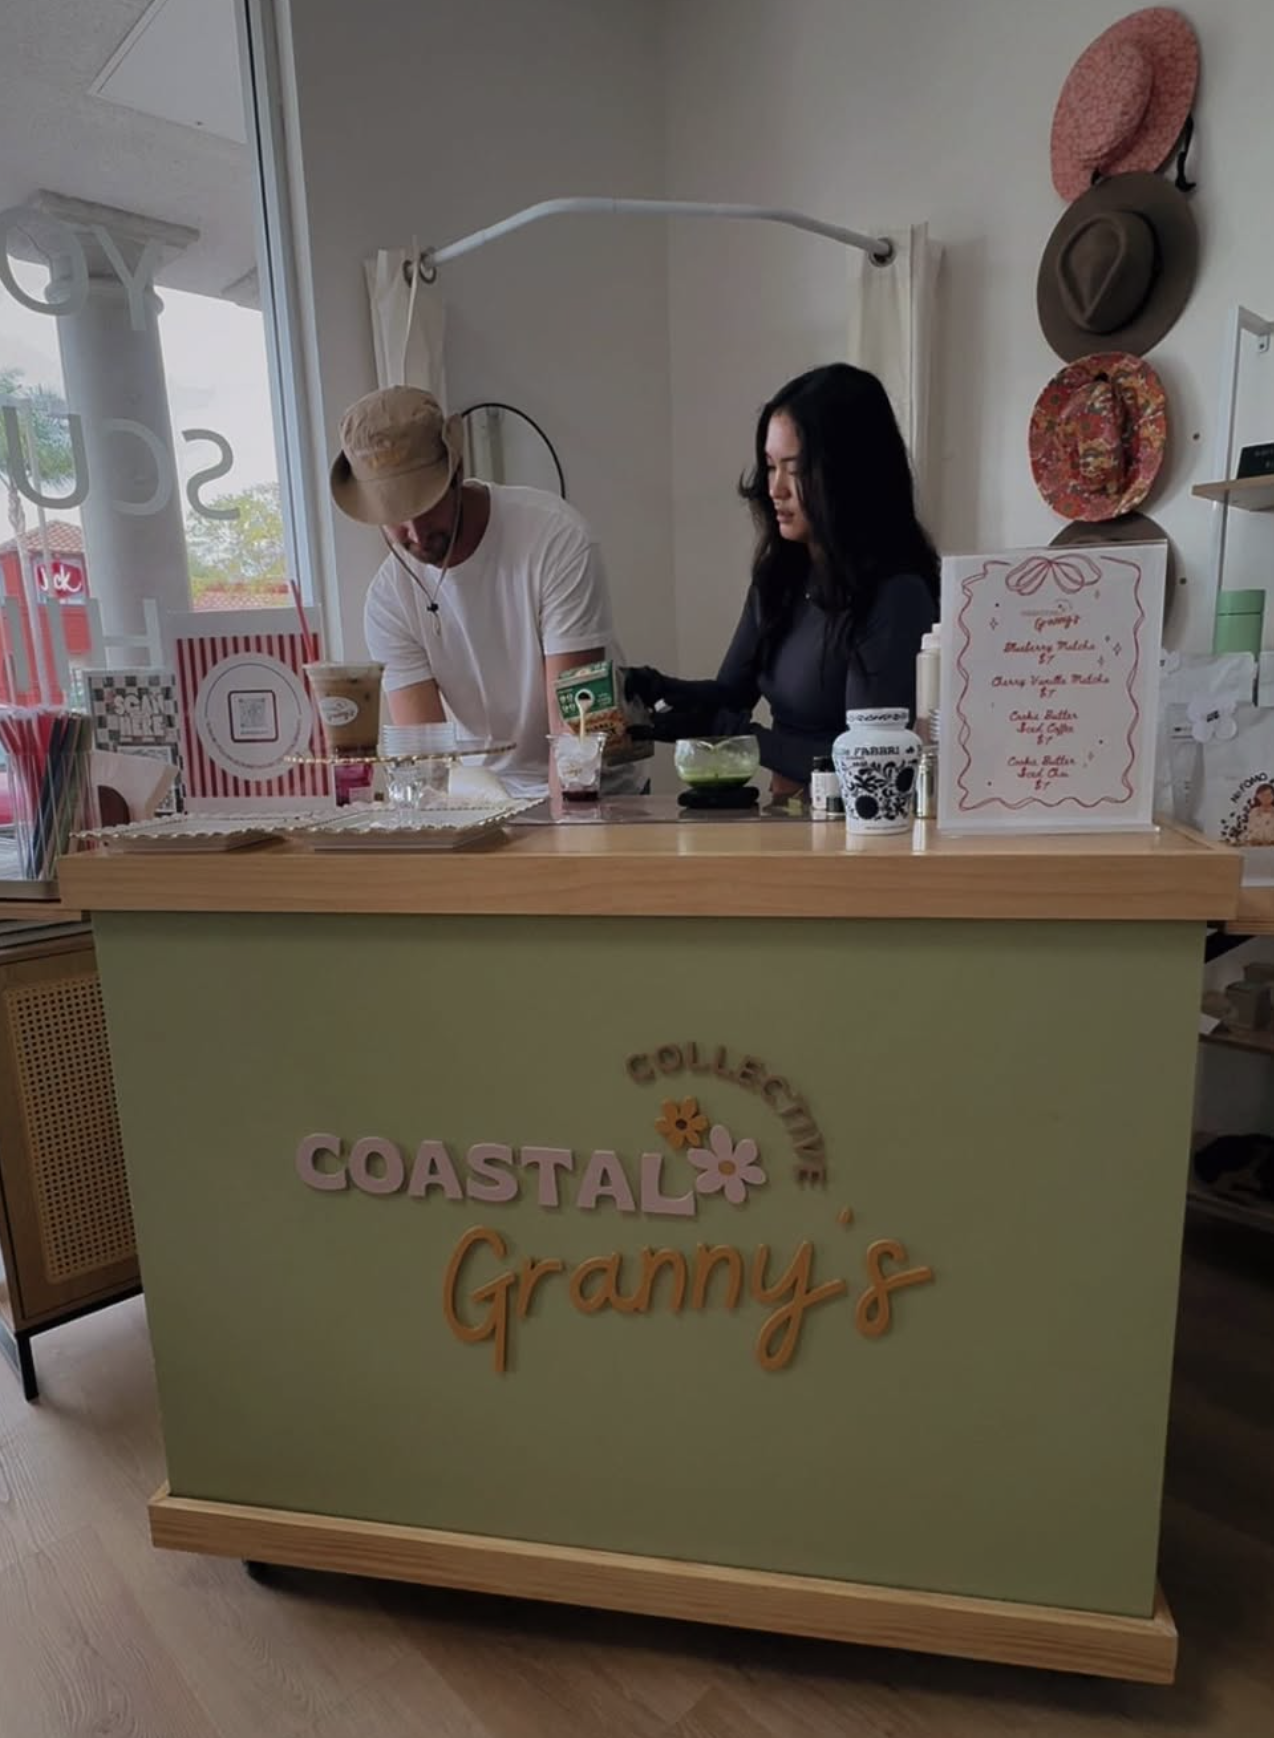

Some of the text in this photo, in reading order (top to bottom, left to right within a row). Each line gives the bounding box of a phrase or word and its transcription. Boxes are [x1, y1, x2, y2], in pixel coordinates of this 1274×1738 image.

[1003, 640, 1096, 654] Blueberry Matcha
[991, 673, 1110, 688] Cherry Vanilla Matcha
[114, 693, 165, 715] SCAN
[1009, 709, 1078, 721] Cookie Butter
[119, 714, 166, 737] HERE
[1016, 721, 1074, 735] Iced Coffee
[853, 746, 901, 756] FABBRI
[1007, 755, 1076, 767] Cookie Butter
[1016, 767, 1044, 778] Iced
[624, 1040, 828, 1191] COLLECTIVE
[296, 1131, 697, 1218] COASTAL
[442, 1206, 934, 1374] Granny's
